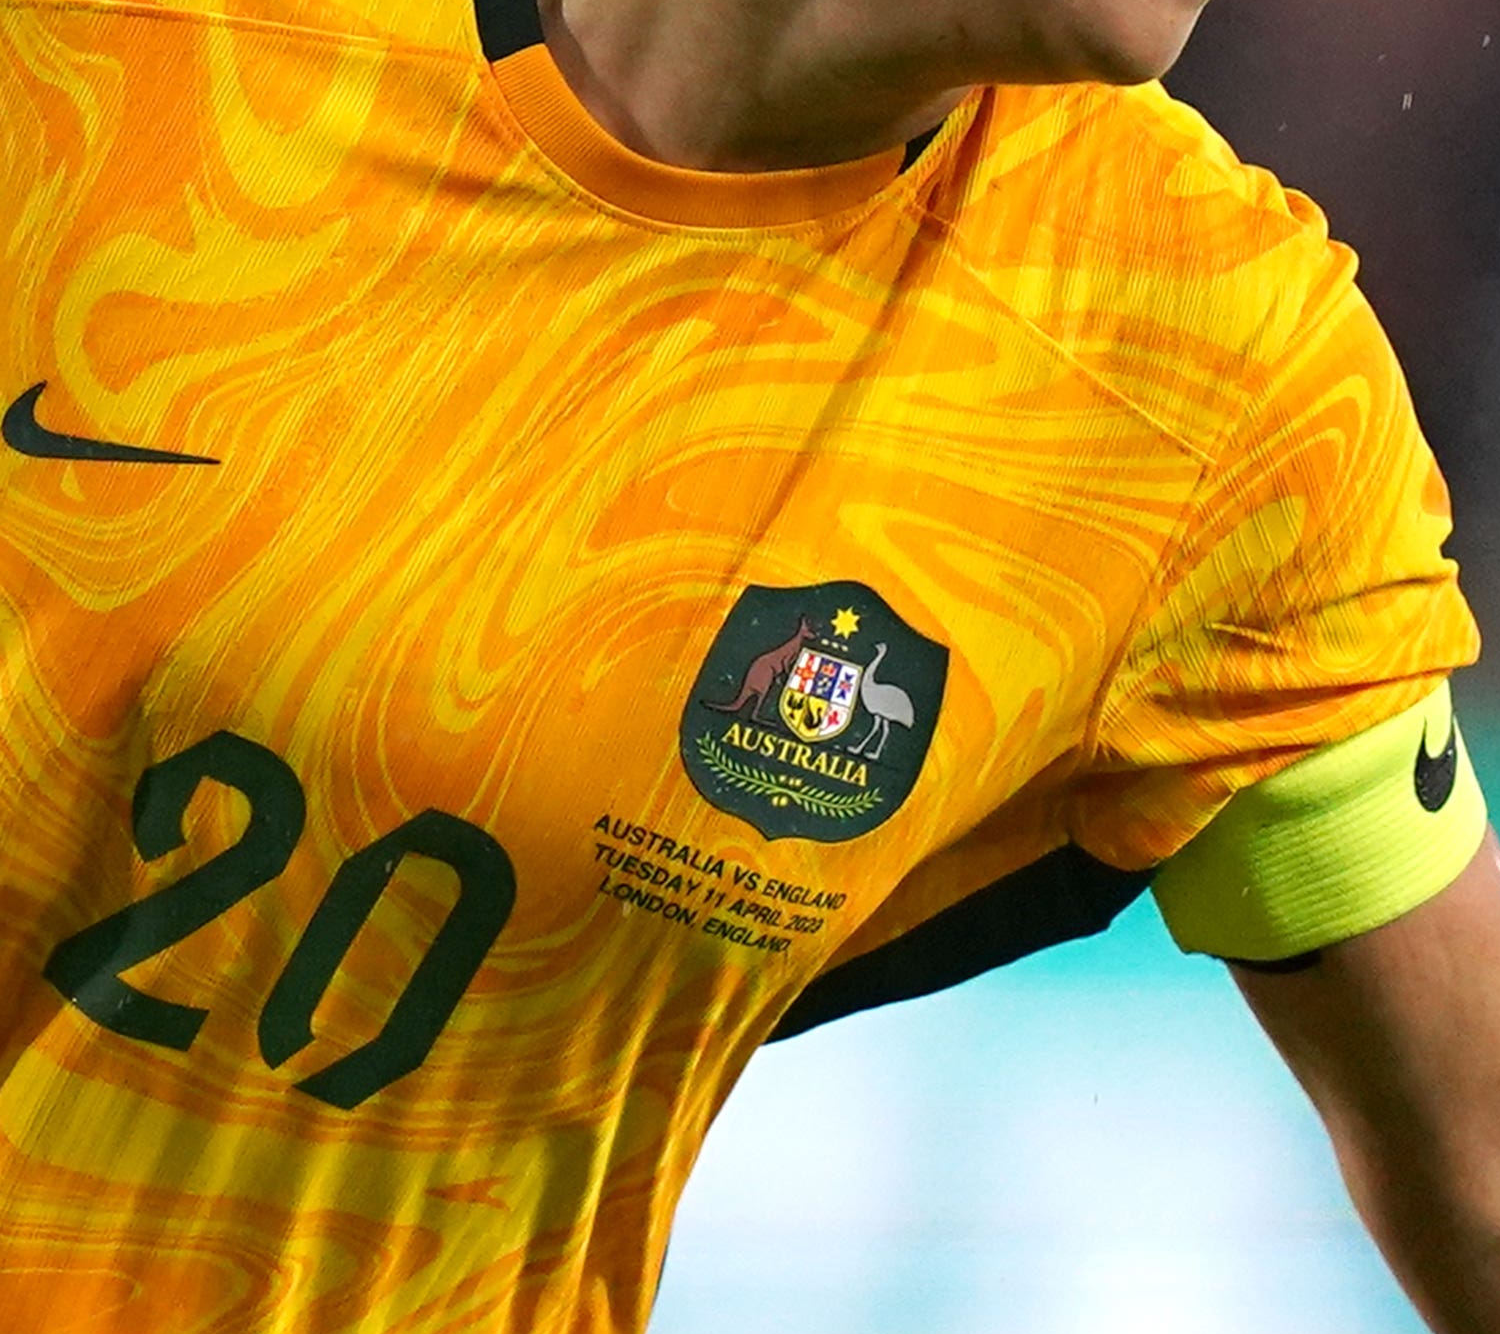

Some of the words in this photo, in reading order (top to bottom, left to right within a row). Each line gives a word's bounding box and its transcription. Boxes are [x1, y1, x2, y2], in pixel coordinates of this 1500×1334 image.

[721, 722, 868, 787] AUSTRALIA
[593, 814, 726, 878] AUSTRALIA
[732, 865, 761, 891] VS
[762, 879, 848, 911] ENGLAND
[594, 843, 701, 896] TUESDAY
[702, 887, 726, 909] 11
[728, 898, 780, 926] APRIL
[42, 729, 517, 1111] 20
[599, 875, 698, 929] LONDON,
[702, 918, 792, 953] ENGLAND
